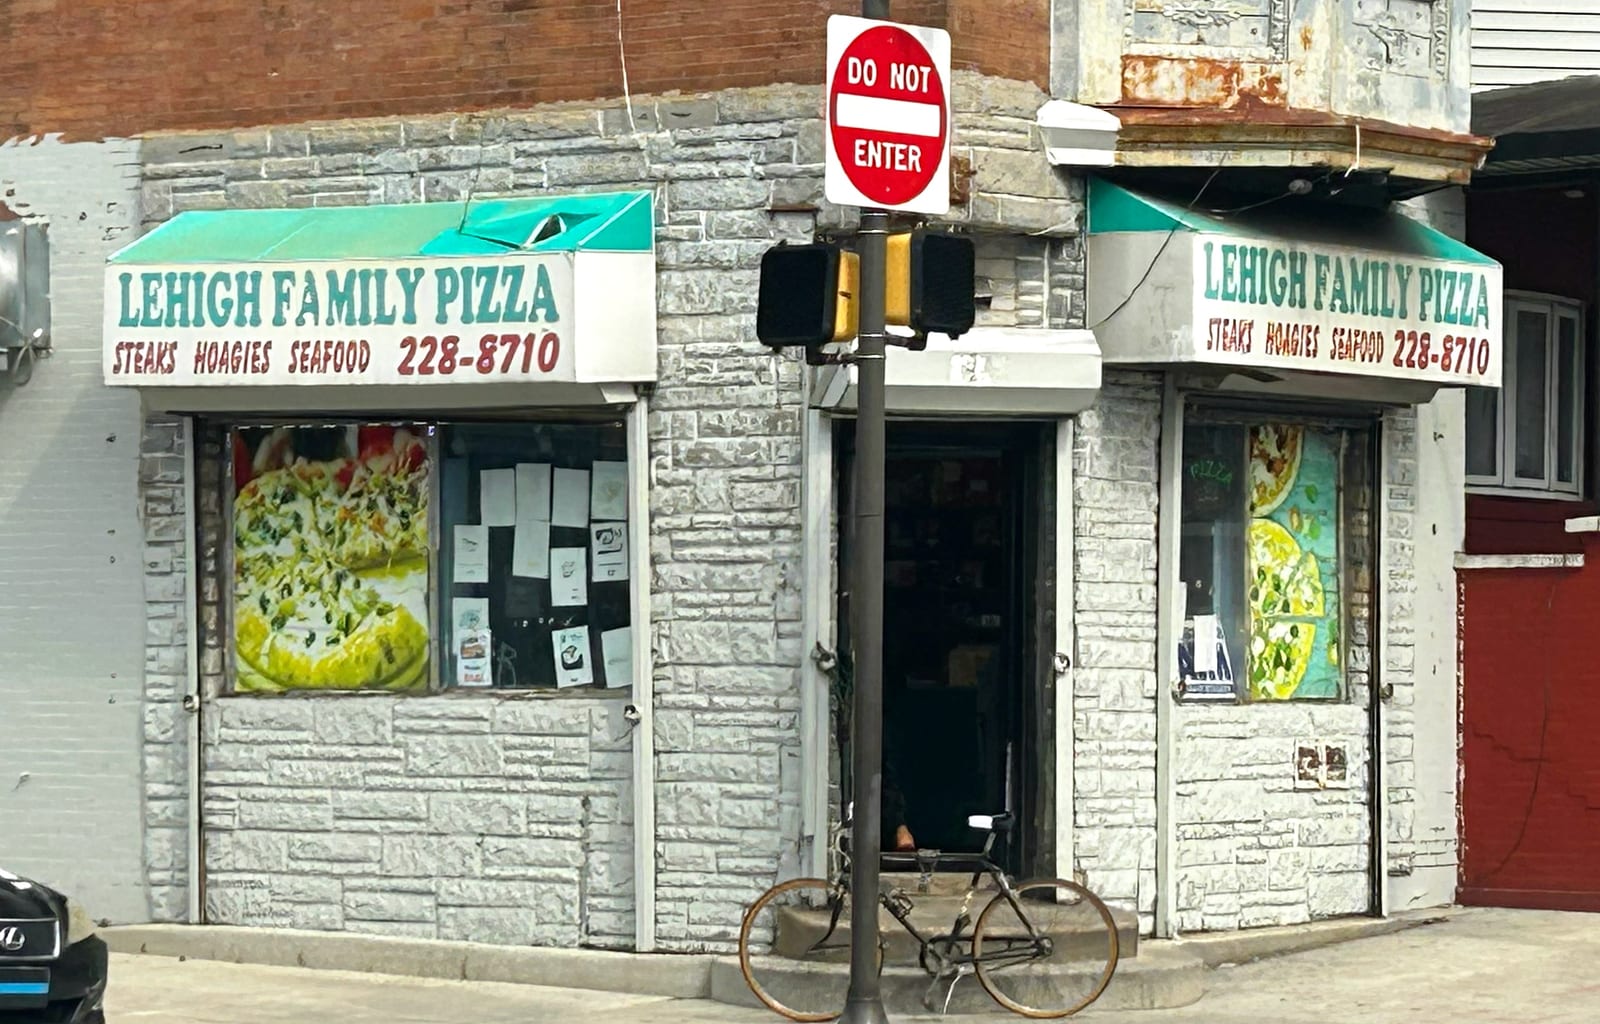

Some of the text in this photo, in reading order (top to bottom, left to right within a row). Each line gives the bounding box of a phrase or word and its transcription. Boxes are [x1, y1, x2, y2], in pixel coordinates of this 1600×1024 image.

[848, 57, 931, 93] DO NOT
[854, 138, 921, 173] ENTER
[118, 264, 560, 327] LEHIGH FAMILY PIZZA
[1204, 241, 1490, 329] LEHIGH FAMILY PIZZA
[112, 332, 560, 375] STEAKS HOAGIES SEAFOOD 228-8710
[1207, 318, 1490, 375] STEAKS HOAGIES SEAFOOD 228-8710
